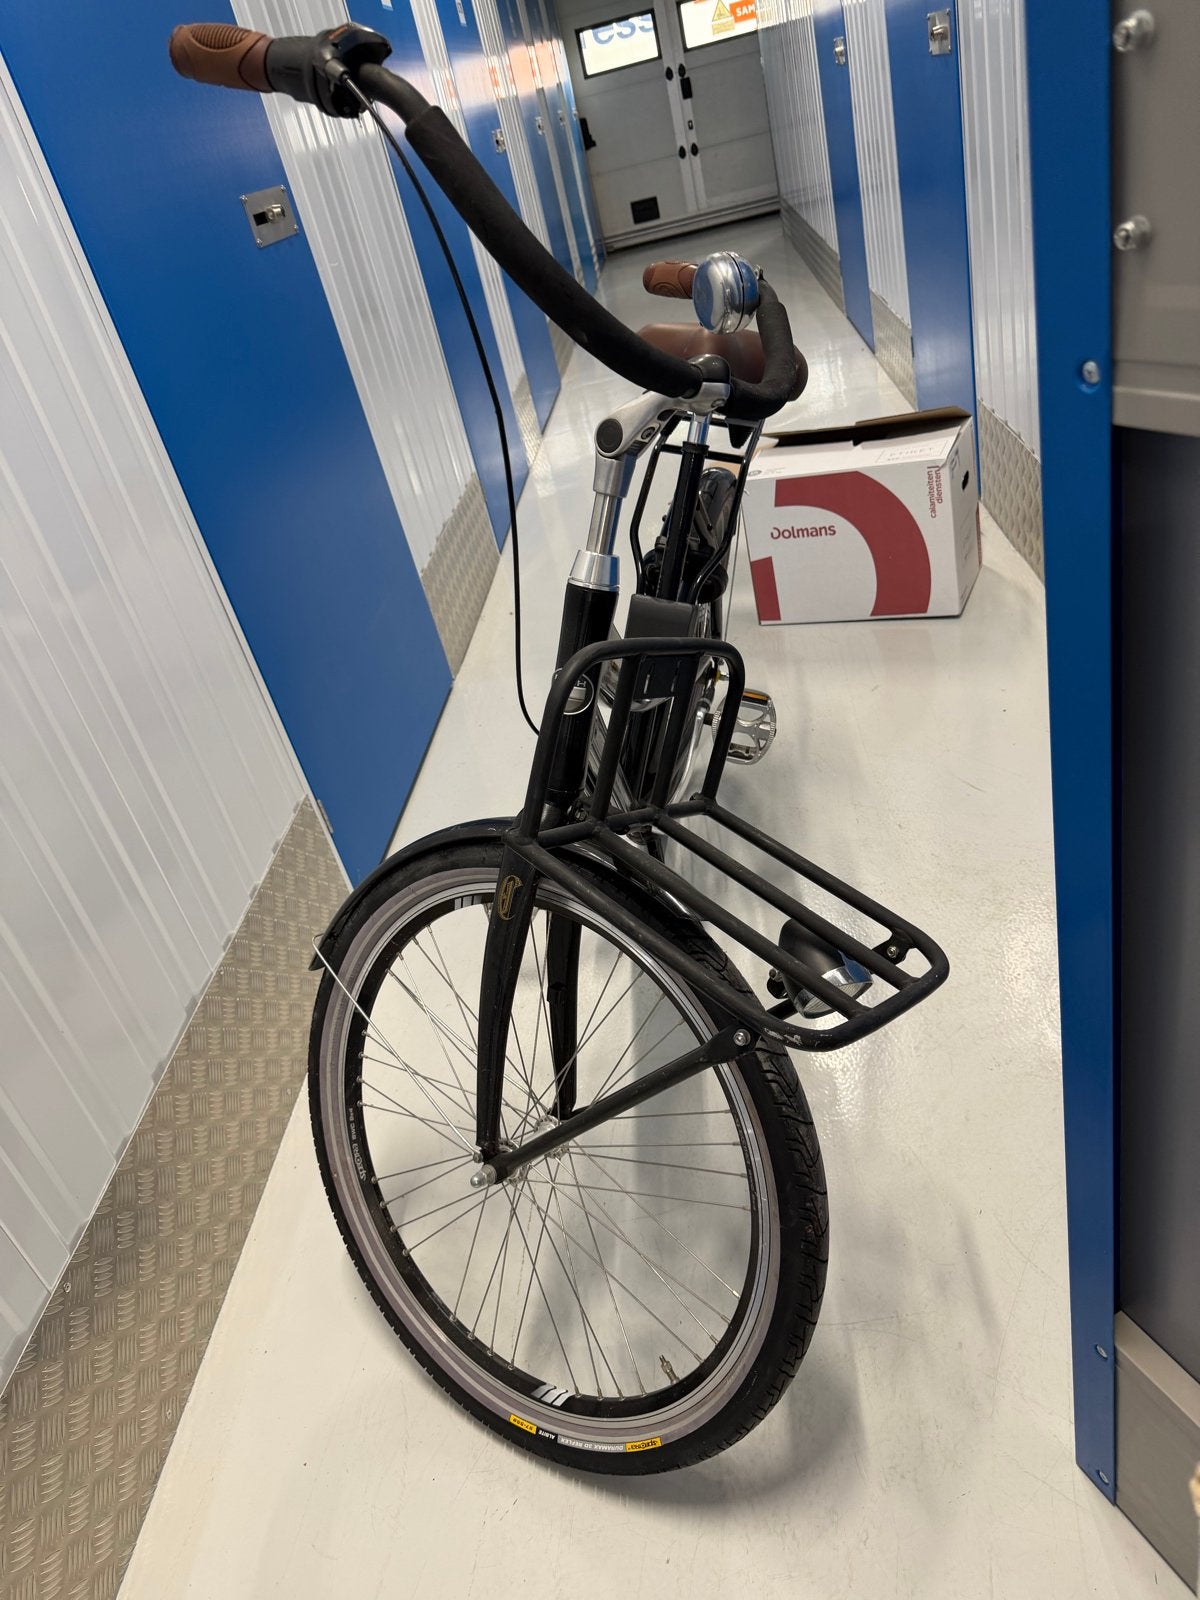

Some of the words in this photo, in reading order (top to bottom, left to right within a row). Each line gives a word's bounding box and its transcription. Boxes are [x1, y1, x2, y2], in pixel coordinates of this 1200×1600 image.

[934, 468, 943, 504] diensten
[928, 469, 937, 519] calamiteiten
[770, 525, 836, 540] Dolmans
[560, 1437, 583, 1448] REFLEX
[594, 1443, 624, 1451] DURAMAX
